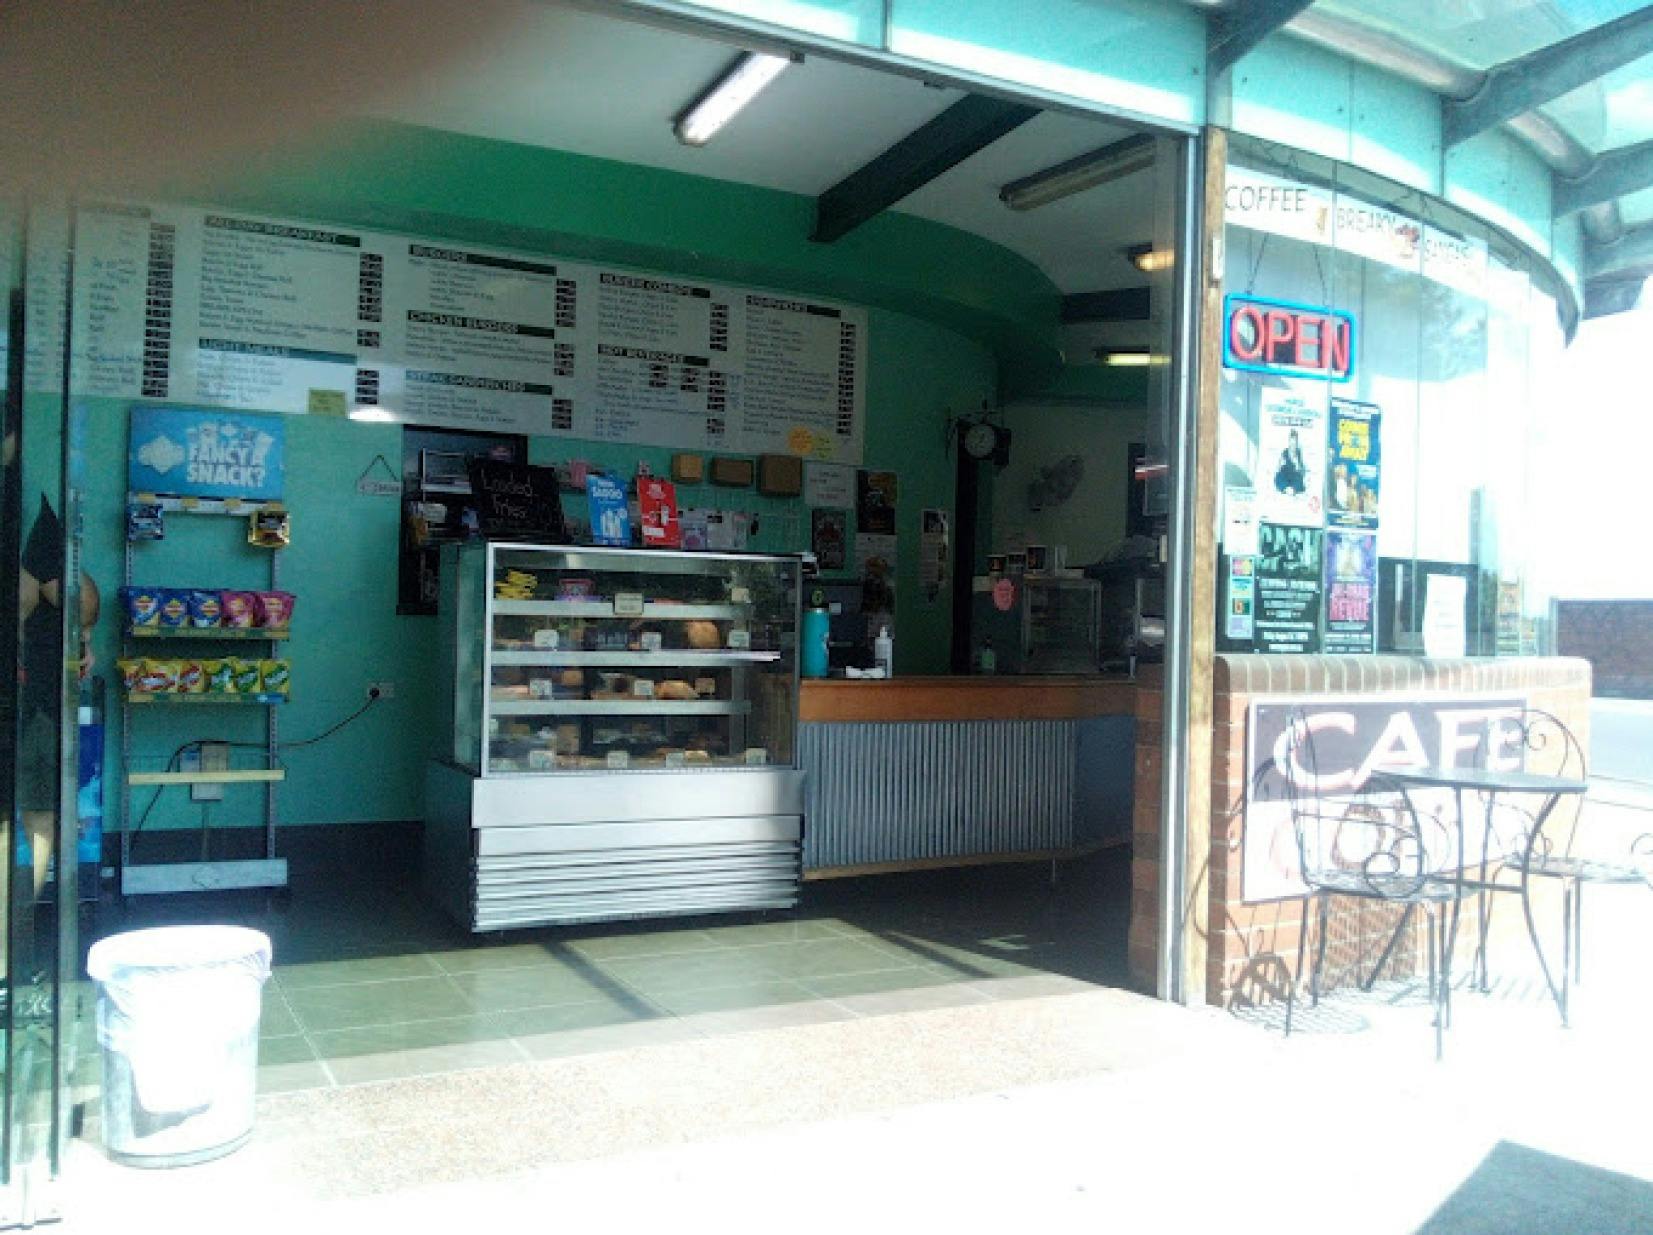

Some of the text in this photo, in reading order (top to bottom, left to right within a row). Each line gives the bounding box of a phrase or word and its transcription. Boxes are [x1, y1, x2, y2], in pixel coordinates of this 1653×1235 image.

[1225, 186, 1308, 212] COFFEE
[1230, 305, 1350, 372] OPEN
[189, 443, 250, 465] FANCY
[187, 464, 264, 487] SNACK?
[481, 468, 534, 497] Loaded
[492, 495, 528, 519] Fries
[1273, 708, 1521, 790] CAFE
